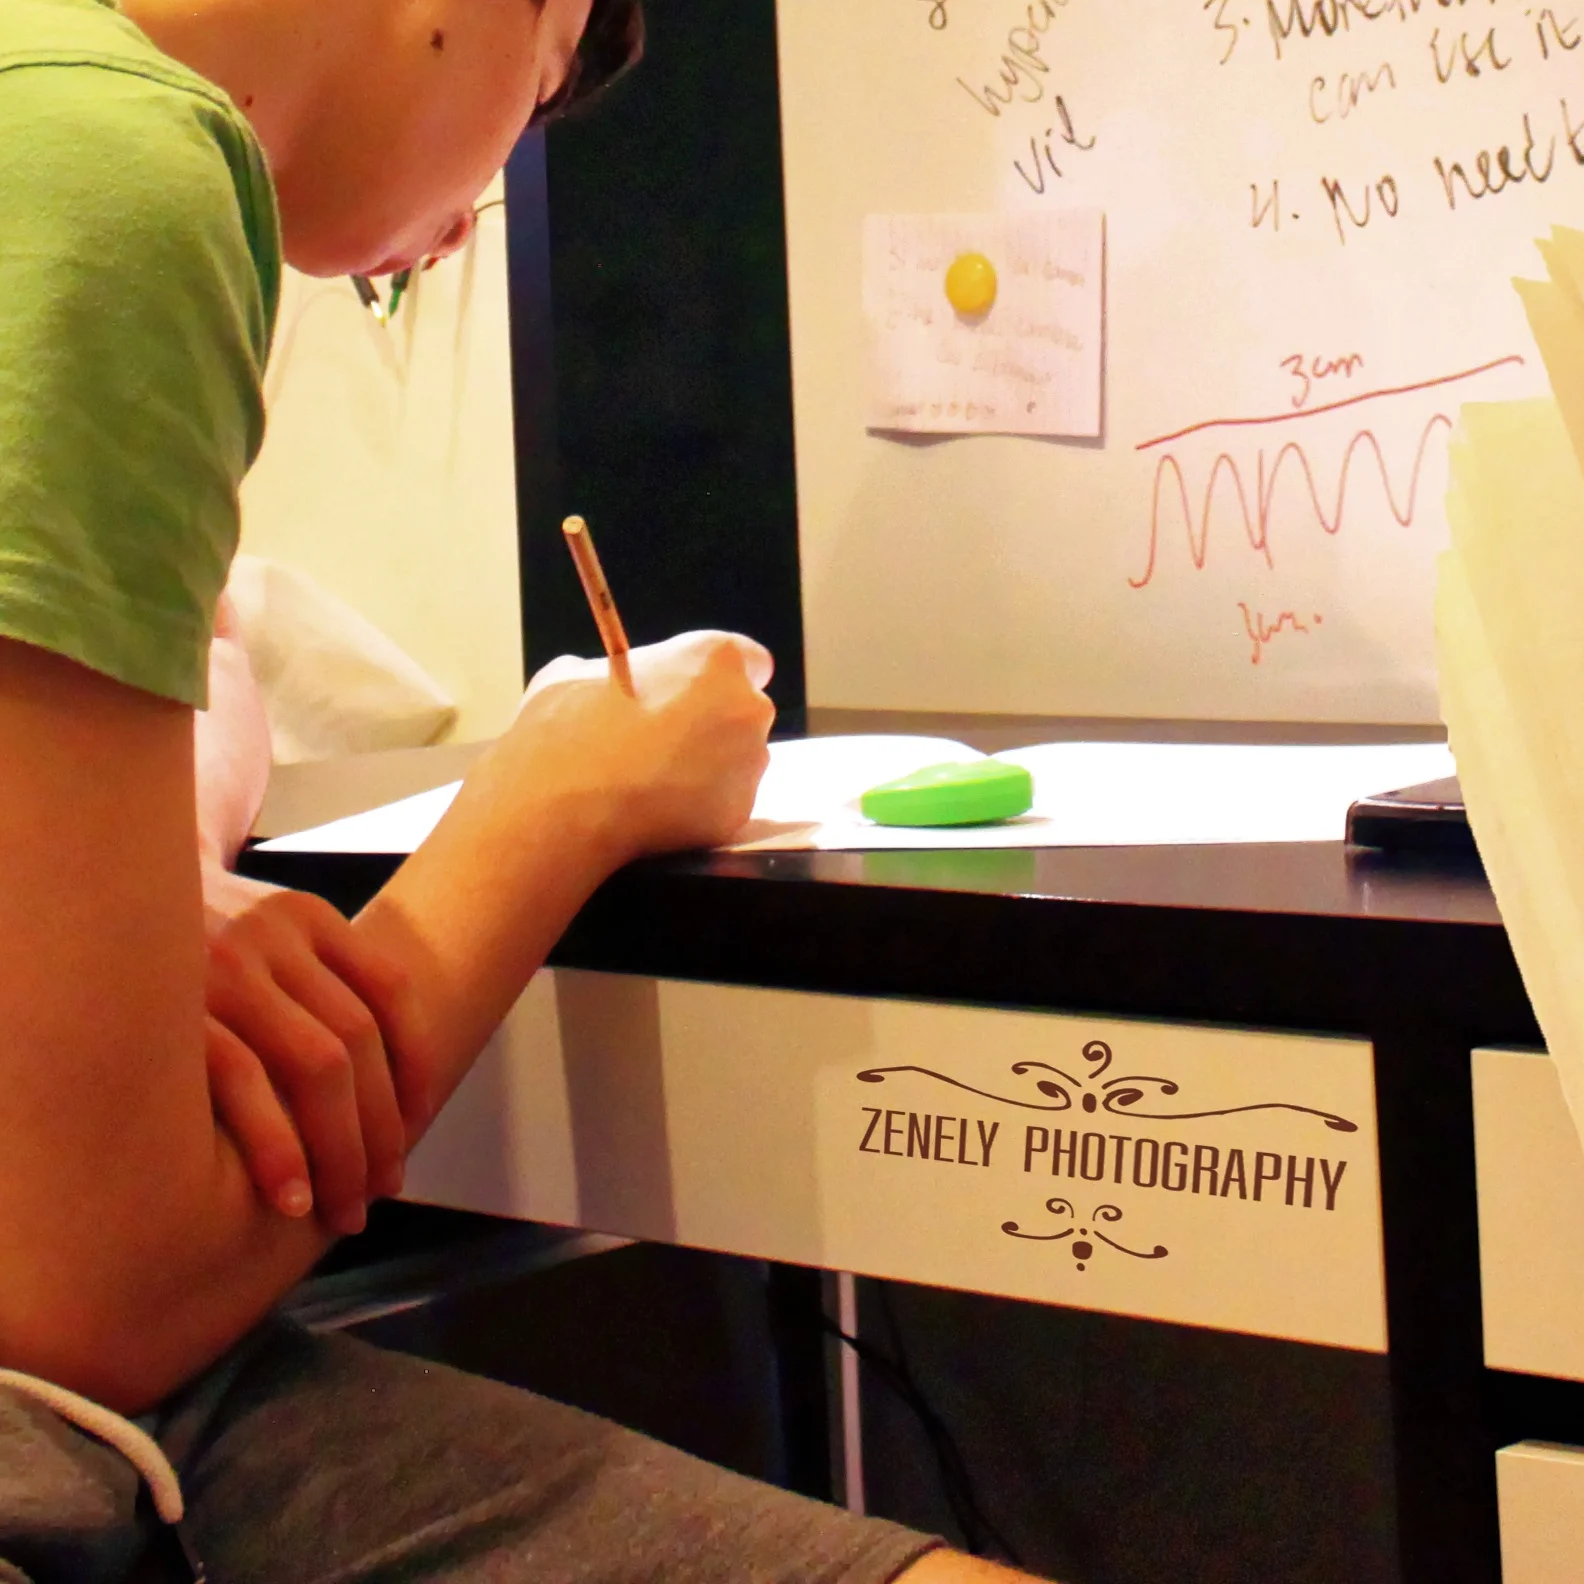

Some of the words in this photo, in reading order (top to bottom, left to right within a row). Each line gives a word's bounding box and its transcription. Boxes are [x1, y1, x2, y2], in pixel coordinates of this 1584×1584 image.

[1308, 60, 1397, 125] can
[1320, 173, 1399, 246] No
[1434, 112, 1556, 211] need
